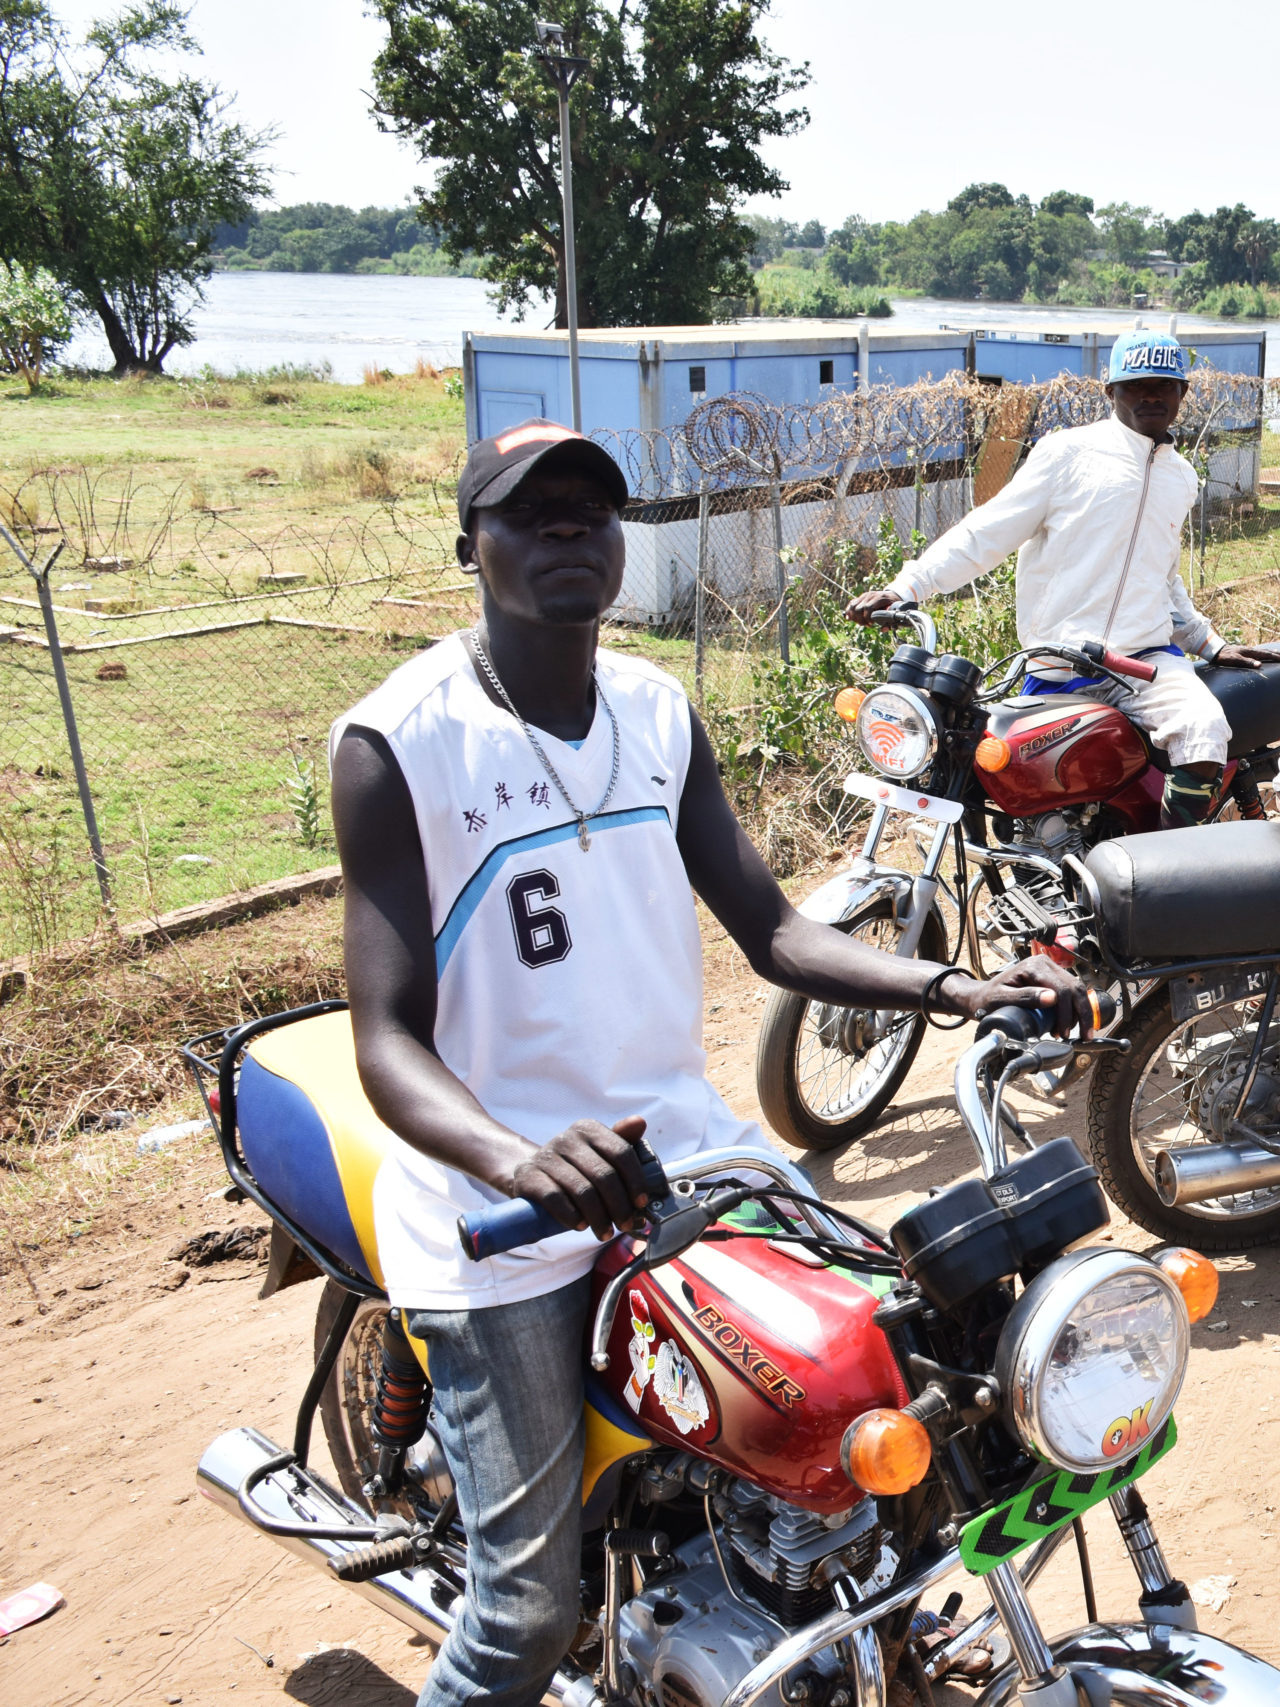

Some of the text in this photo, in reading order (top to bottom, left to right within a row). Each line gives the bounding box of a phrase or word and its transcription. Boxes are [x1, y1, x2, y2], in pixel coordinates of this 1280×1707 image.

[1121, 345, 1177, 371] MAGIC
[1018, 723, 1073, 759] BOXER
[505, 868, 573, 970] 6
[691, 1303, 806, 1409] BOXER
[1101, 1396, 1155, 1457] OK
